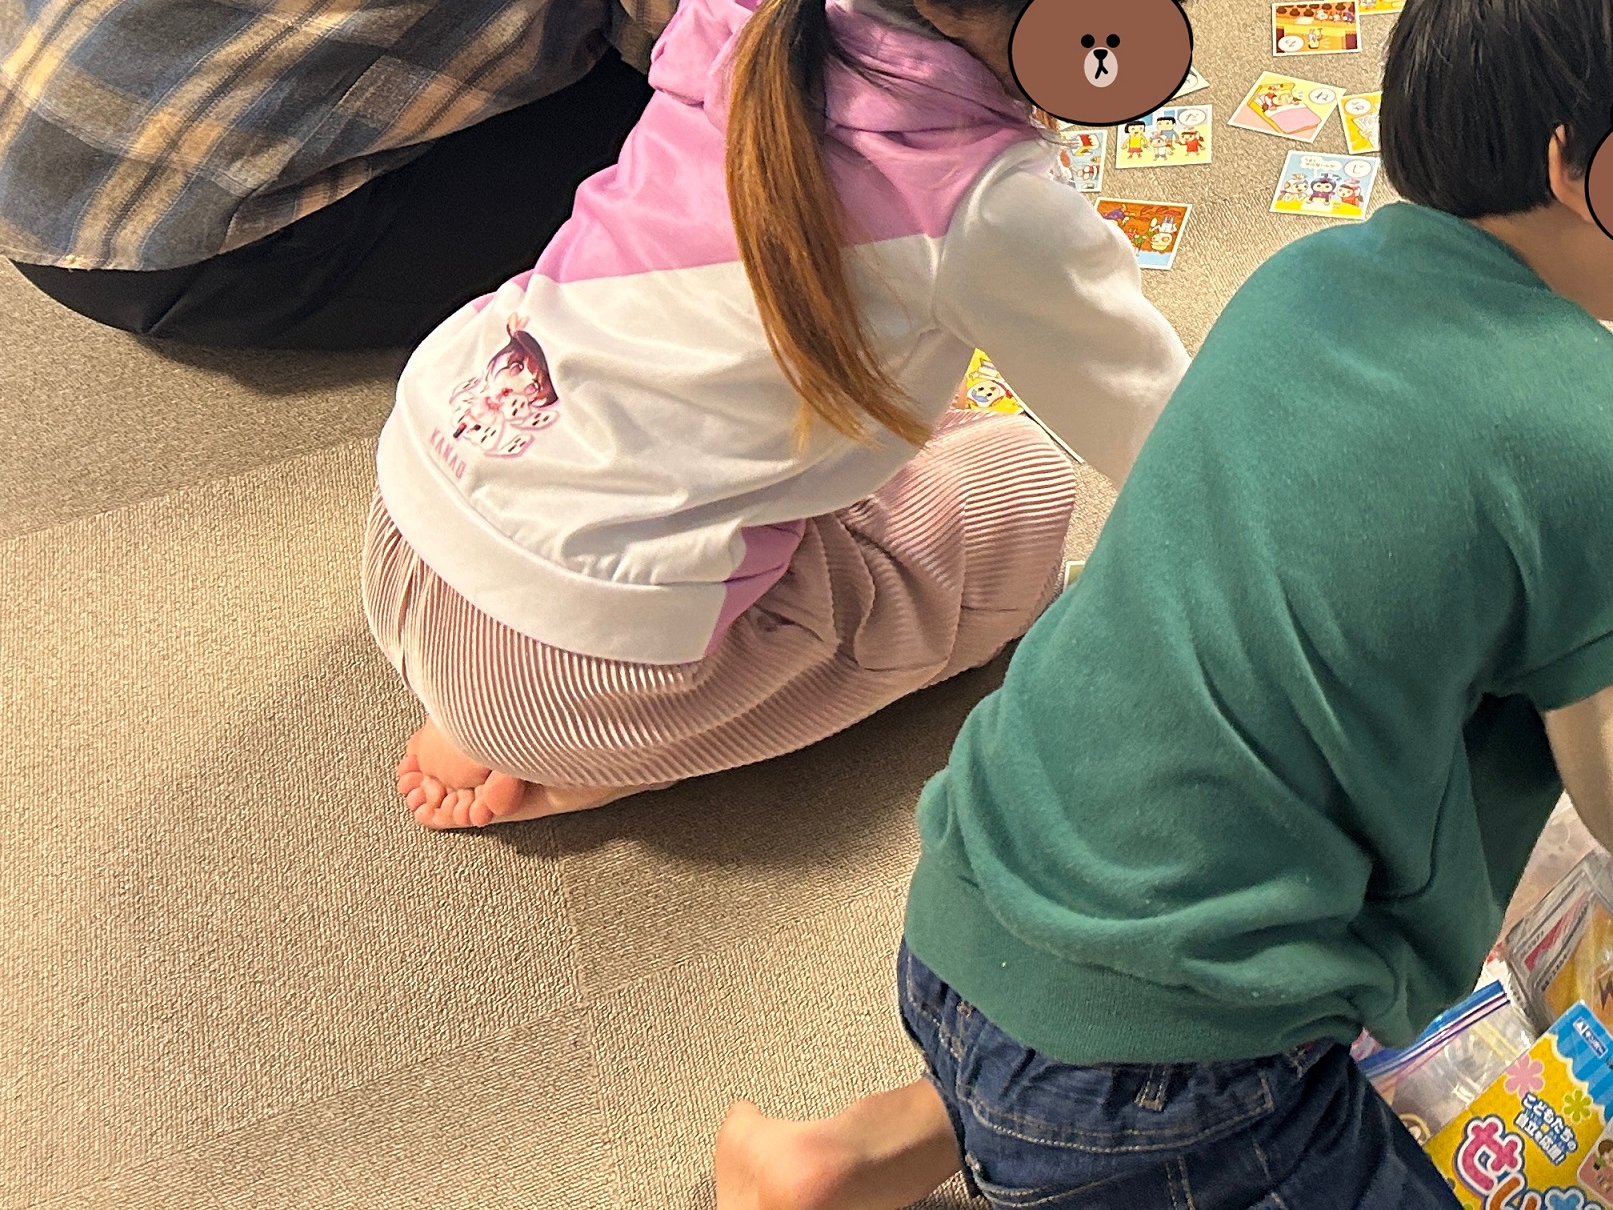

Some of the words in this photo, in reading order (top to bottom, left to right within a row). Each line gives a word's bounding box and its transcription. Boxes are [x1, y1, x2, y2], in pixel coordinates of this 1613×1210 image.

[430, 428, 466, 480] KANAO
[1523, 1093, 1578, 1152] こどもたちの
